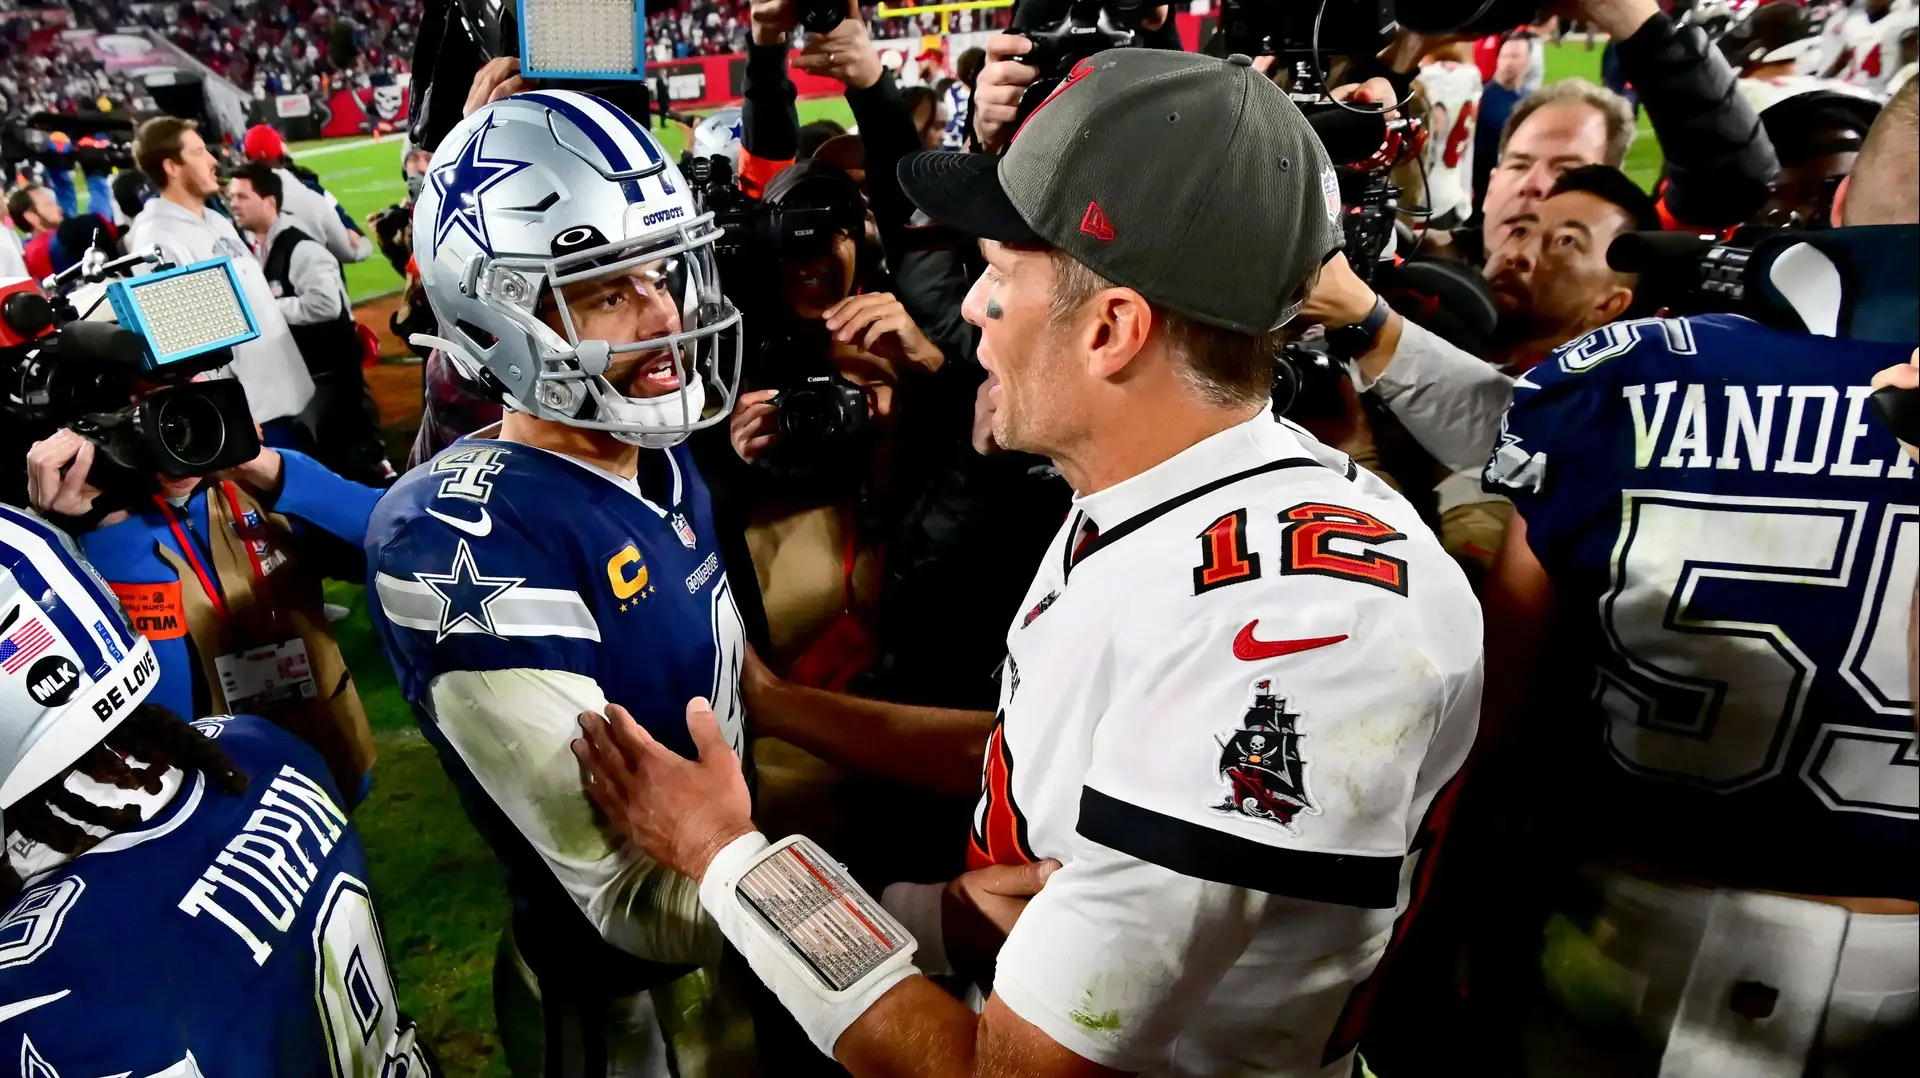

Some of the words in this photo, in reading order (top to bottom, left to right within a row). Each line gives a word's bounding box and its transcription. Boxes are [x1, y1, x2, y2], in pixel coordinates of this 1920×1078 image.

[642, 206, 685, 226] COWBOYS
[1622, 380, 1915, 480] VANDE
[429, 447, 513, 504] 4
[606, 545, 648, 601] C
[686, 551, 719, 594] COWBOYS
[1193, 501, 1408, 598] 12
[96, 623, 121, 661] URPIN
[136, 615, 179, 631] WILD
[32, 662, 77, 701] MLK
[92, 685, 125, 722] BE
[123, 649, 156, 697] LOVE
[178, 764, 348, 967] TURPIN
